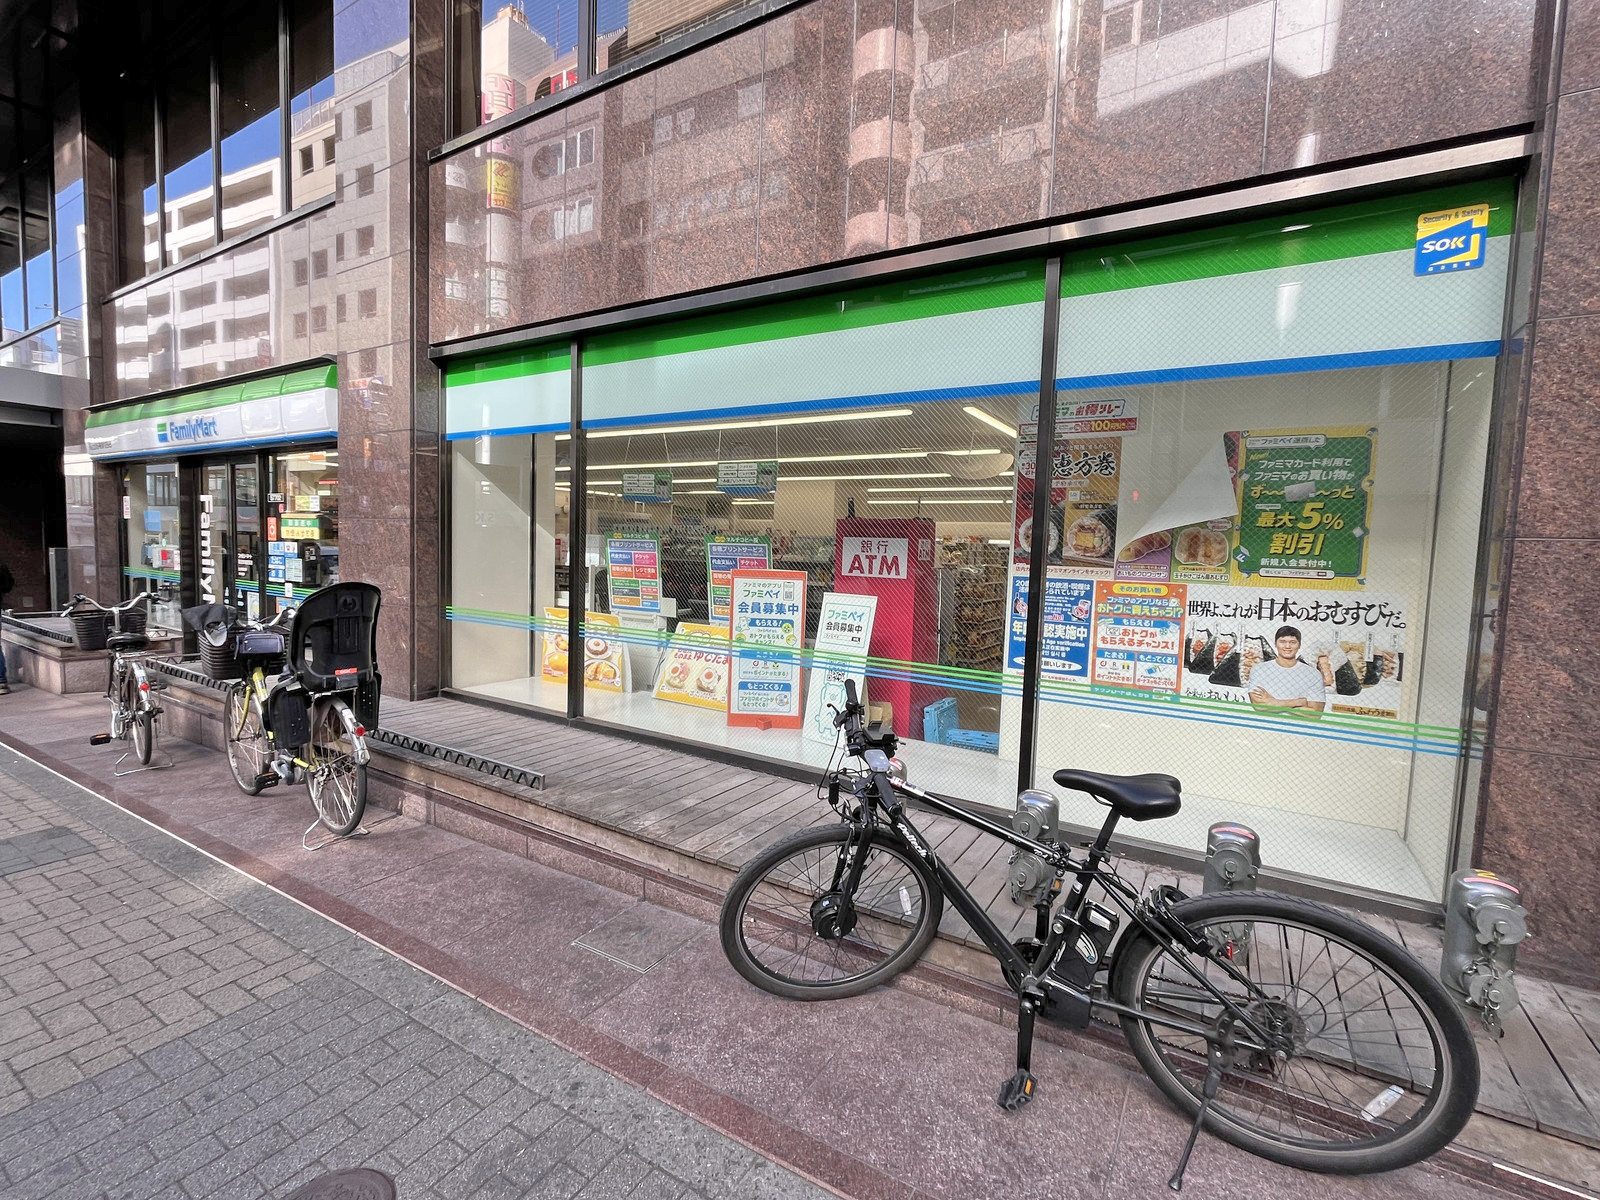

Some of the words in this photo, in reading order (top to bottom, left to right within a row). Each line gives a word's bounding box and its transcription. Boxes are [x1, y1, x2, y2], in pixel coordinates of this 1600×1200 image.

[1423, 213, 1452, 224] Security
[1462, 208, 1484, 217] Safety
[169, 417, 219, 441] FamilyMart
[1053, 452, 1117, 477] 恵方巻
[1259, 457, 1352, 469] ファミマカード利用で
[1254, 469, 1355, 481] ファミマのお買い物が
[861, 540, 888, 553] 銀行
[1269, 533, 1325, 556] 割引
[848, 554, 900, 575] ATM
[1261, 558, 1332, 568] 新規入会受付中!
[743, 589, 781, 598] ファミペイ
[1107, 596, 1168, 606] ファミマのアプリなら
[738, 602, 799, 615] 会員募集中
[1187, 598, 1407, 629] 世界よ、これが日本のおむすびだ。
[828, 609, 865, 622] ファミペイ
[826, 621, 862, 634] 会員募集中
[1122, 618, 1154, 627] もらえる!
[1122, 628, 1157, 638] おトクが
[1100, 636, 1175, 650] もらえるチャンス!
[1104, 651, 1127, 659] たまる!
[1139, 654, 1175, 664] もどってくる!
